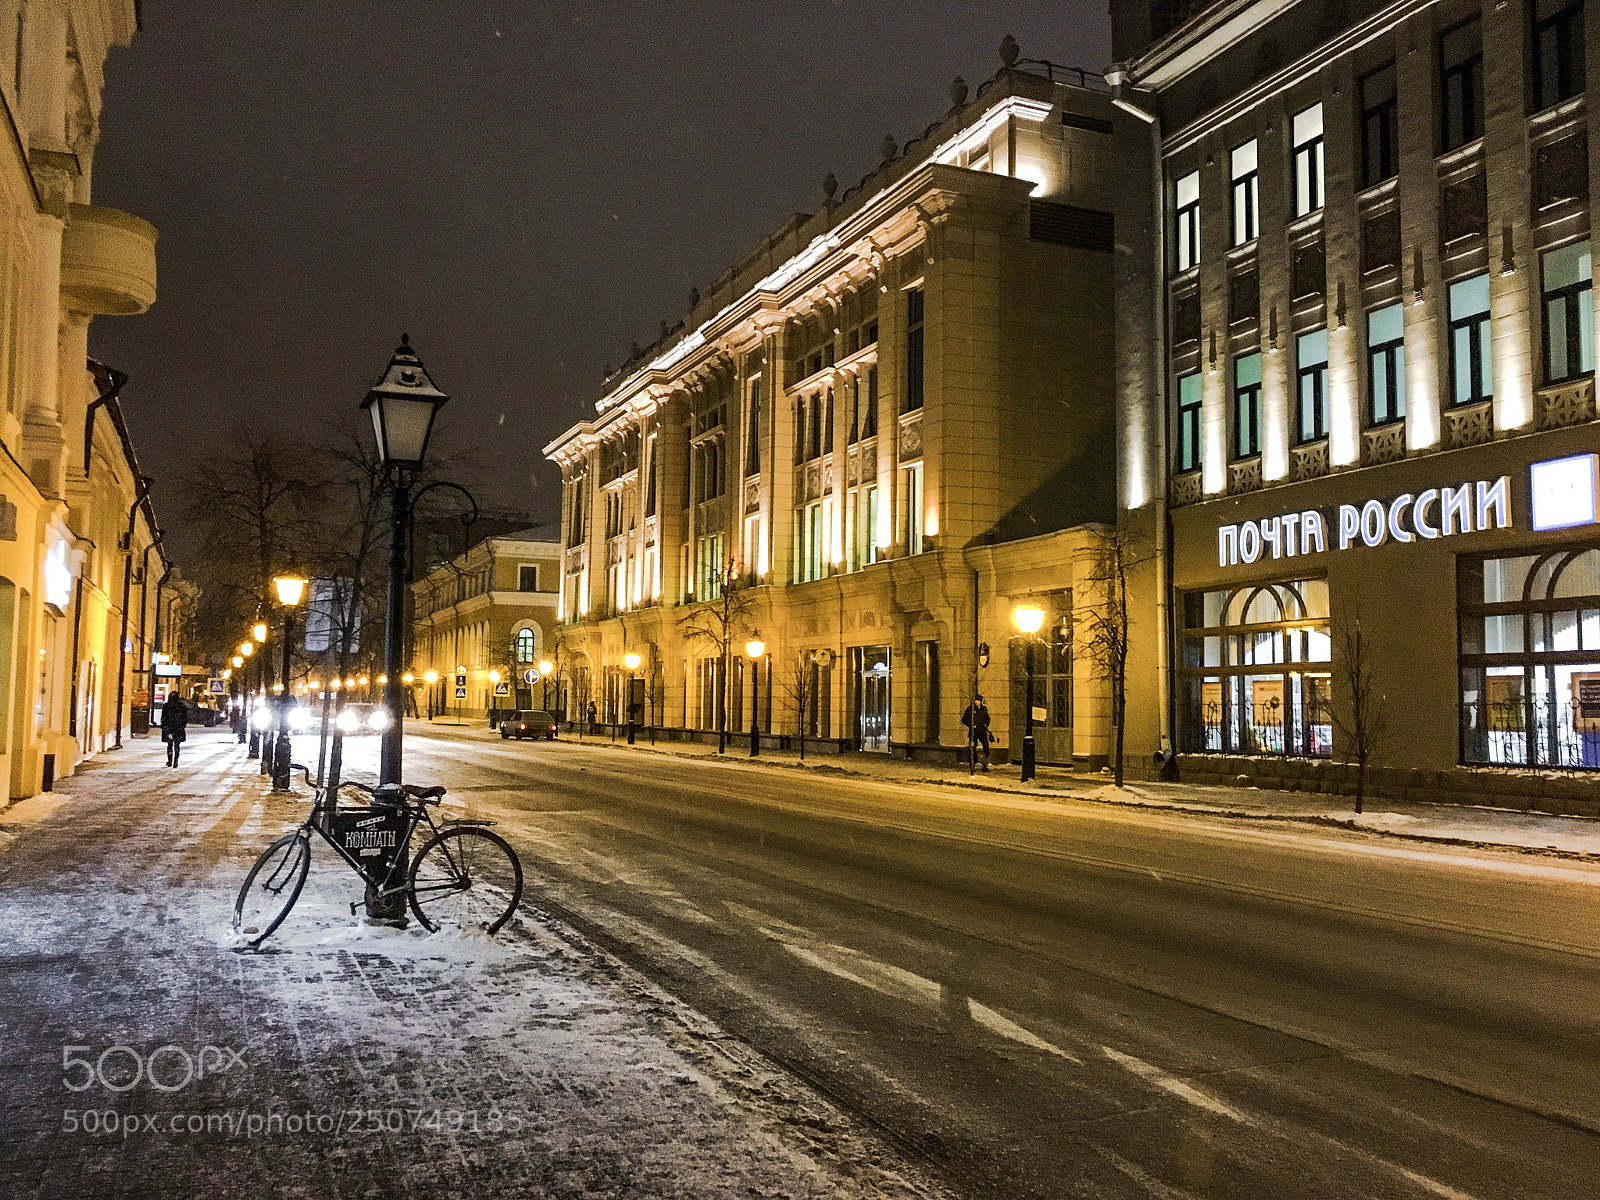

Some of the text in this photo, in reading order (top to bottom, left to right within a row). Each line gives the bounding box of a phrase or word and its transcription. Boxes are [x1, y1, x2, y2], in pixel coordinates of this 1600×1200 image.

[1218, 475, 1512, 567] ПОЧТА РОССИИ
[345, 831, 396, 848] КОМНАТЫ
